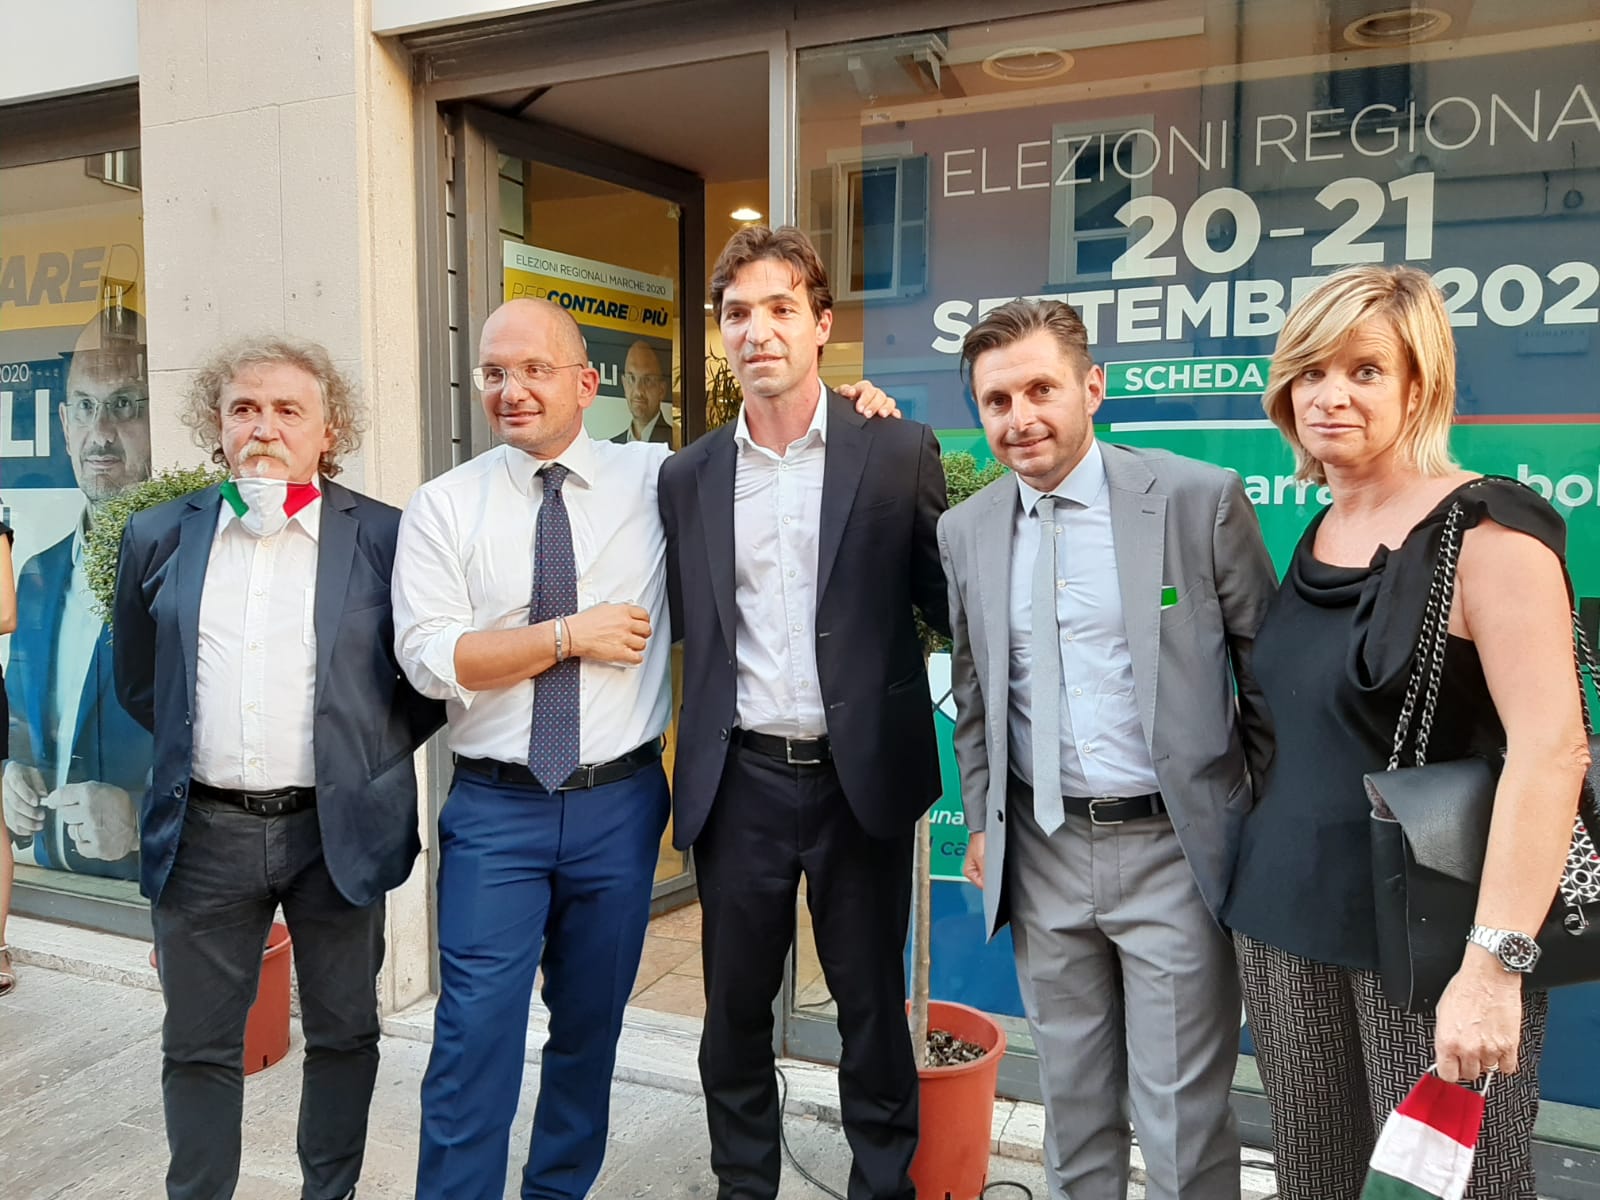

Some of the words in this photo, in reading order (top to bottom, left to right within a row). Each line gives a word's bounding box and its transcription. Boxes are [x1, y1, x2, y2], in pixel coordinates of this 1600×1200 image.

[943, 118, 1228, 198] ELEZIONI
[1255, 84, 1600, 166] REGIONA
[0, 246, 106, 307] ARE
[515, 254, 558, 273] ELEZIONI
[560, 264, 608, 284] REGIONALI
[609, 273, 645, 292] MARCHE
[646, 283, 666, 296] 2020
[931, 275, 1330, 354] STEMB
[0, 364, 29, 383] 020
[1124, 363, 1265, 392] SCHEDA
